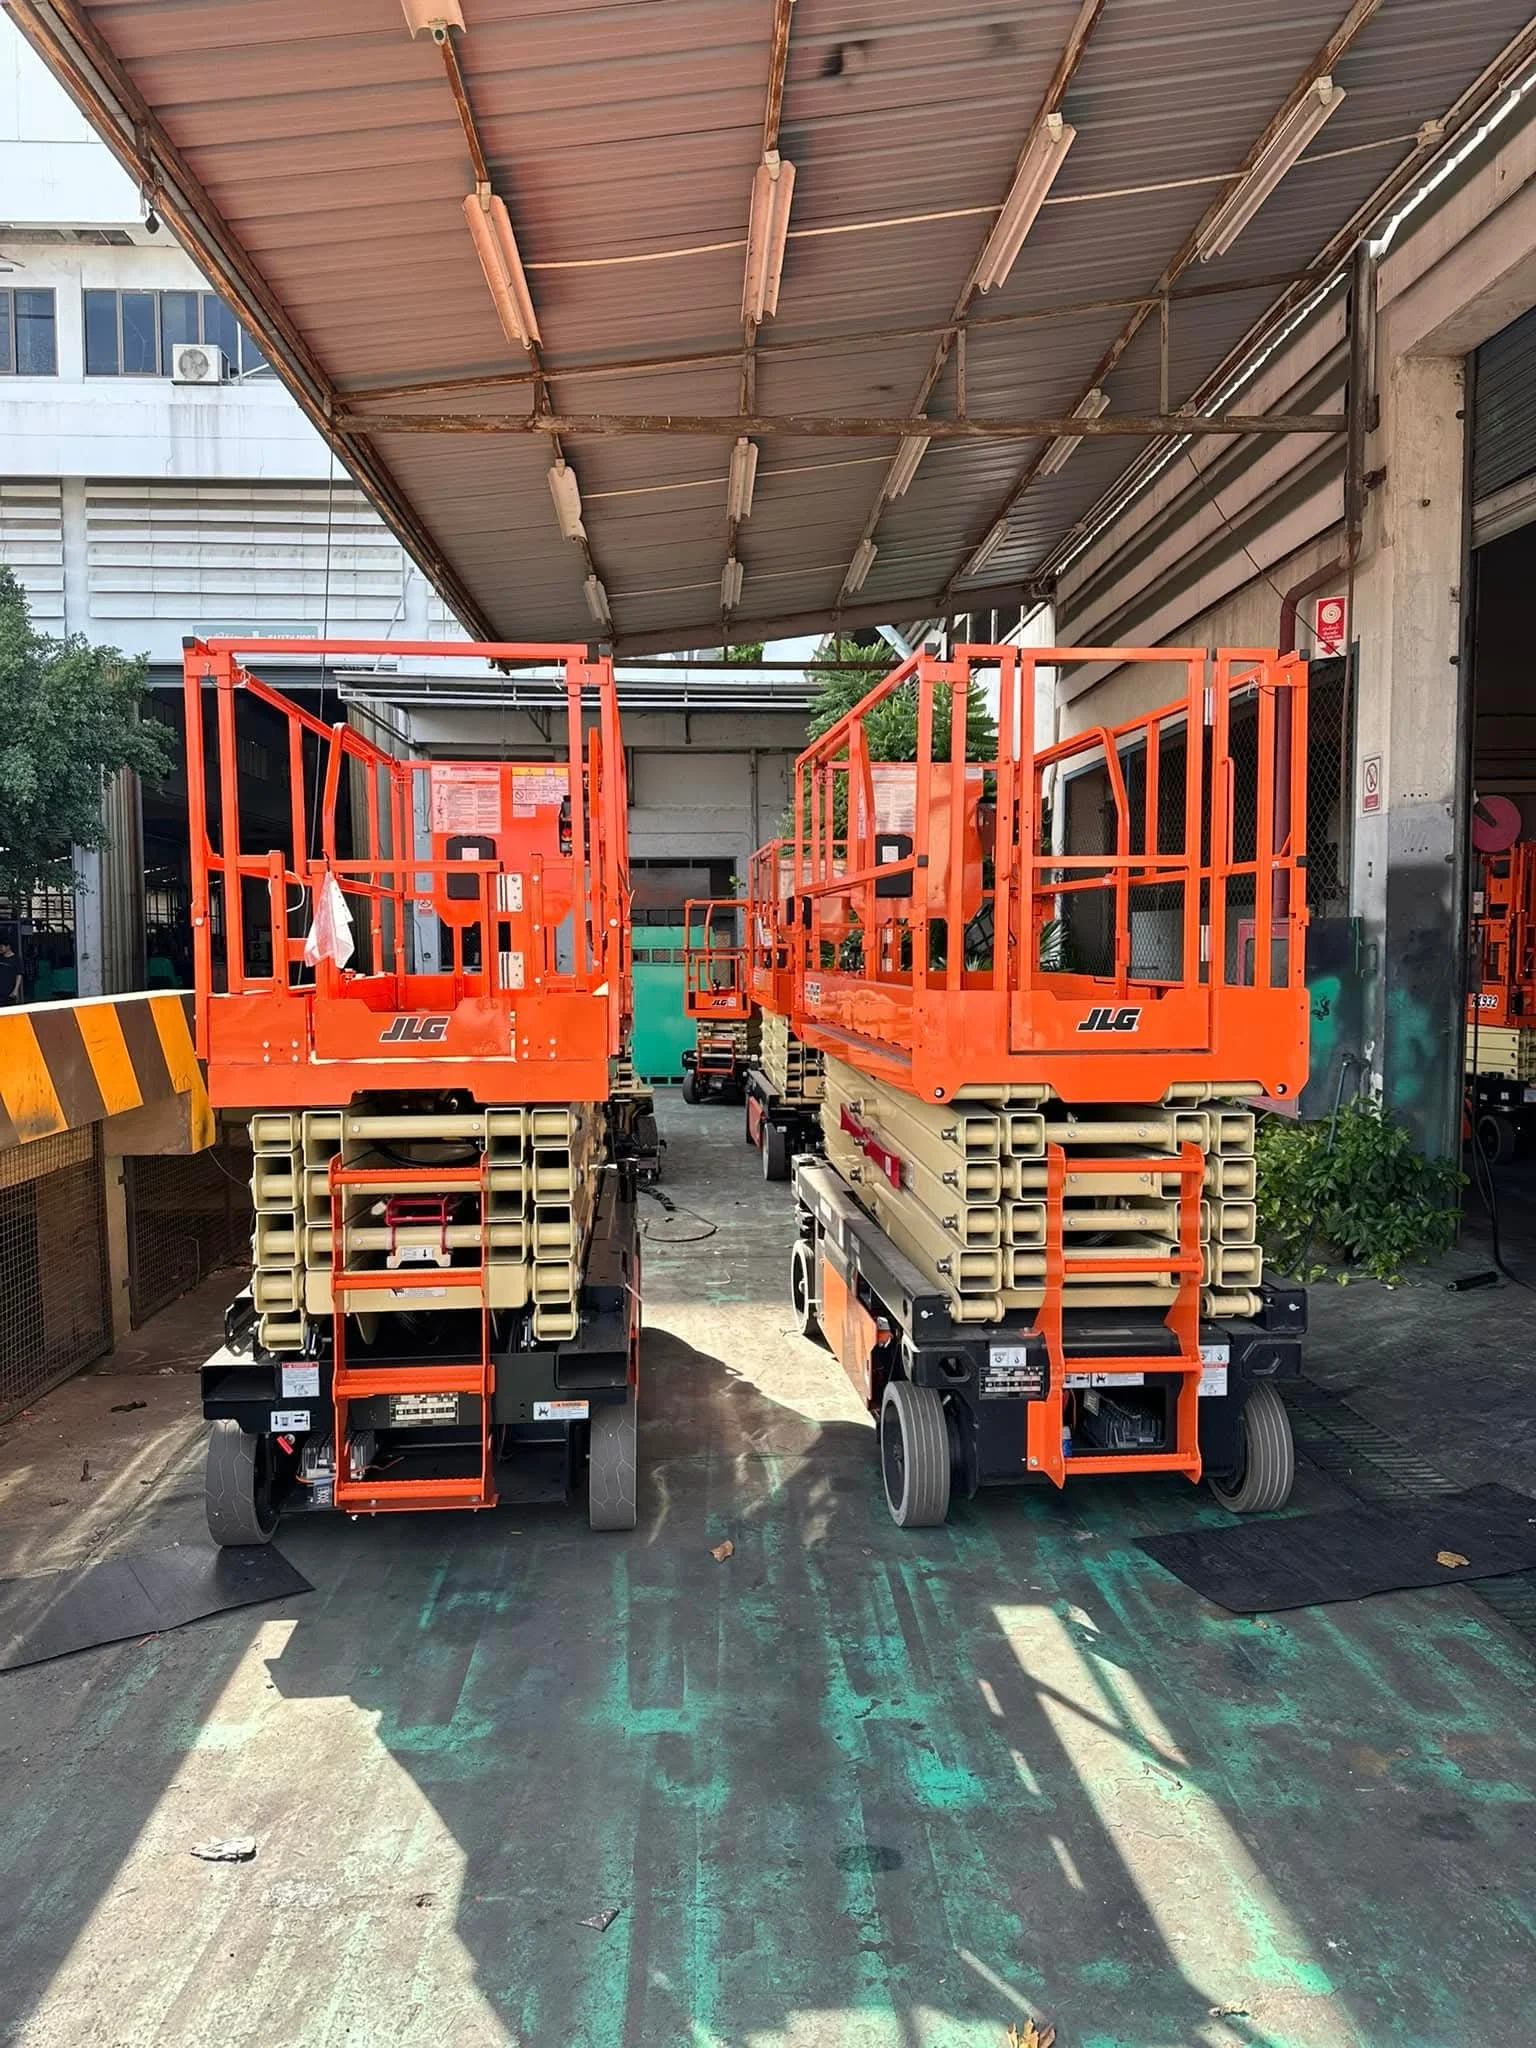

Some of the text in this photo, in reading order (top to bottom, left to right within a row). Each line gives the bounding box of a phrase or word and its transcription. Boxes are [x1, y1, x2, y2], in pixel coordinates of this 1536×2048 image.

[711, 999, 728, 1007] JLG
[379, 1016, 451, 1042] JLG
[1076, 1007, 1143, 1032] JLG
